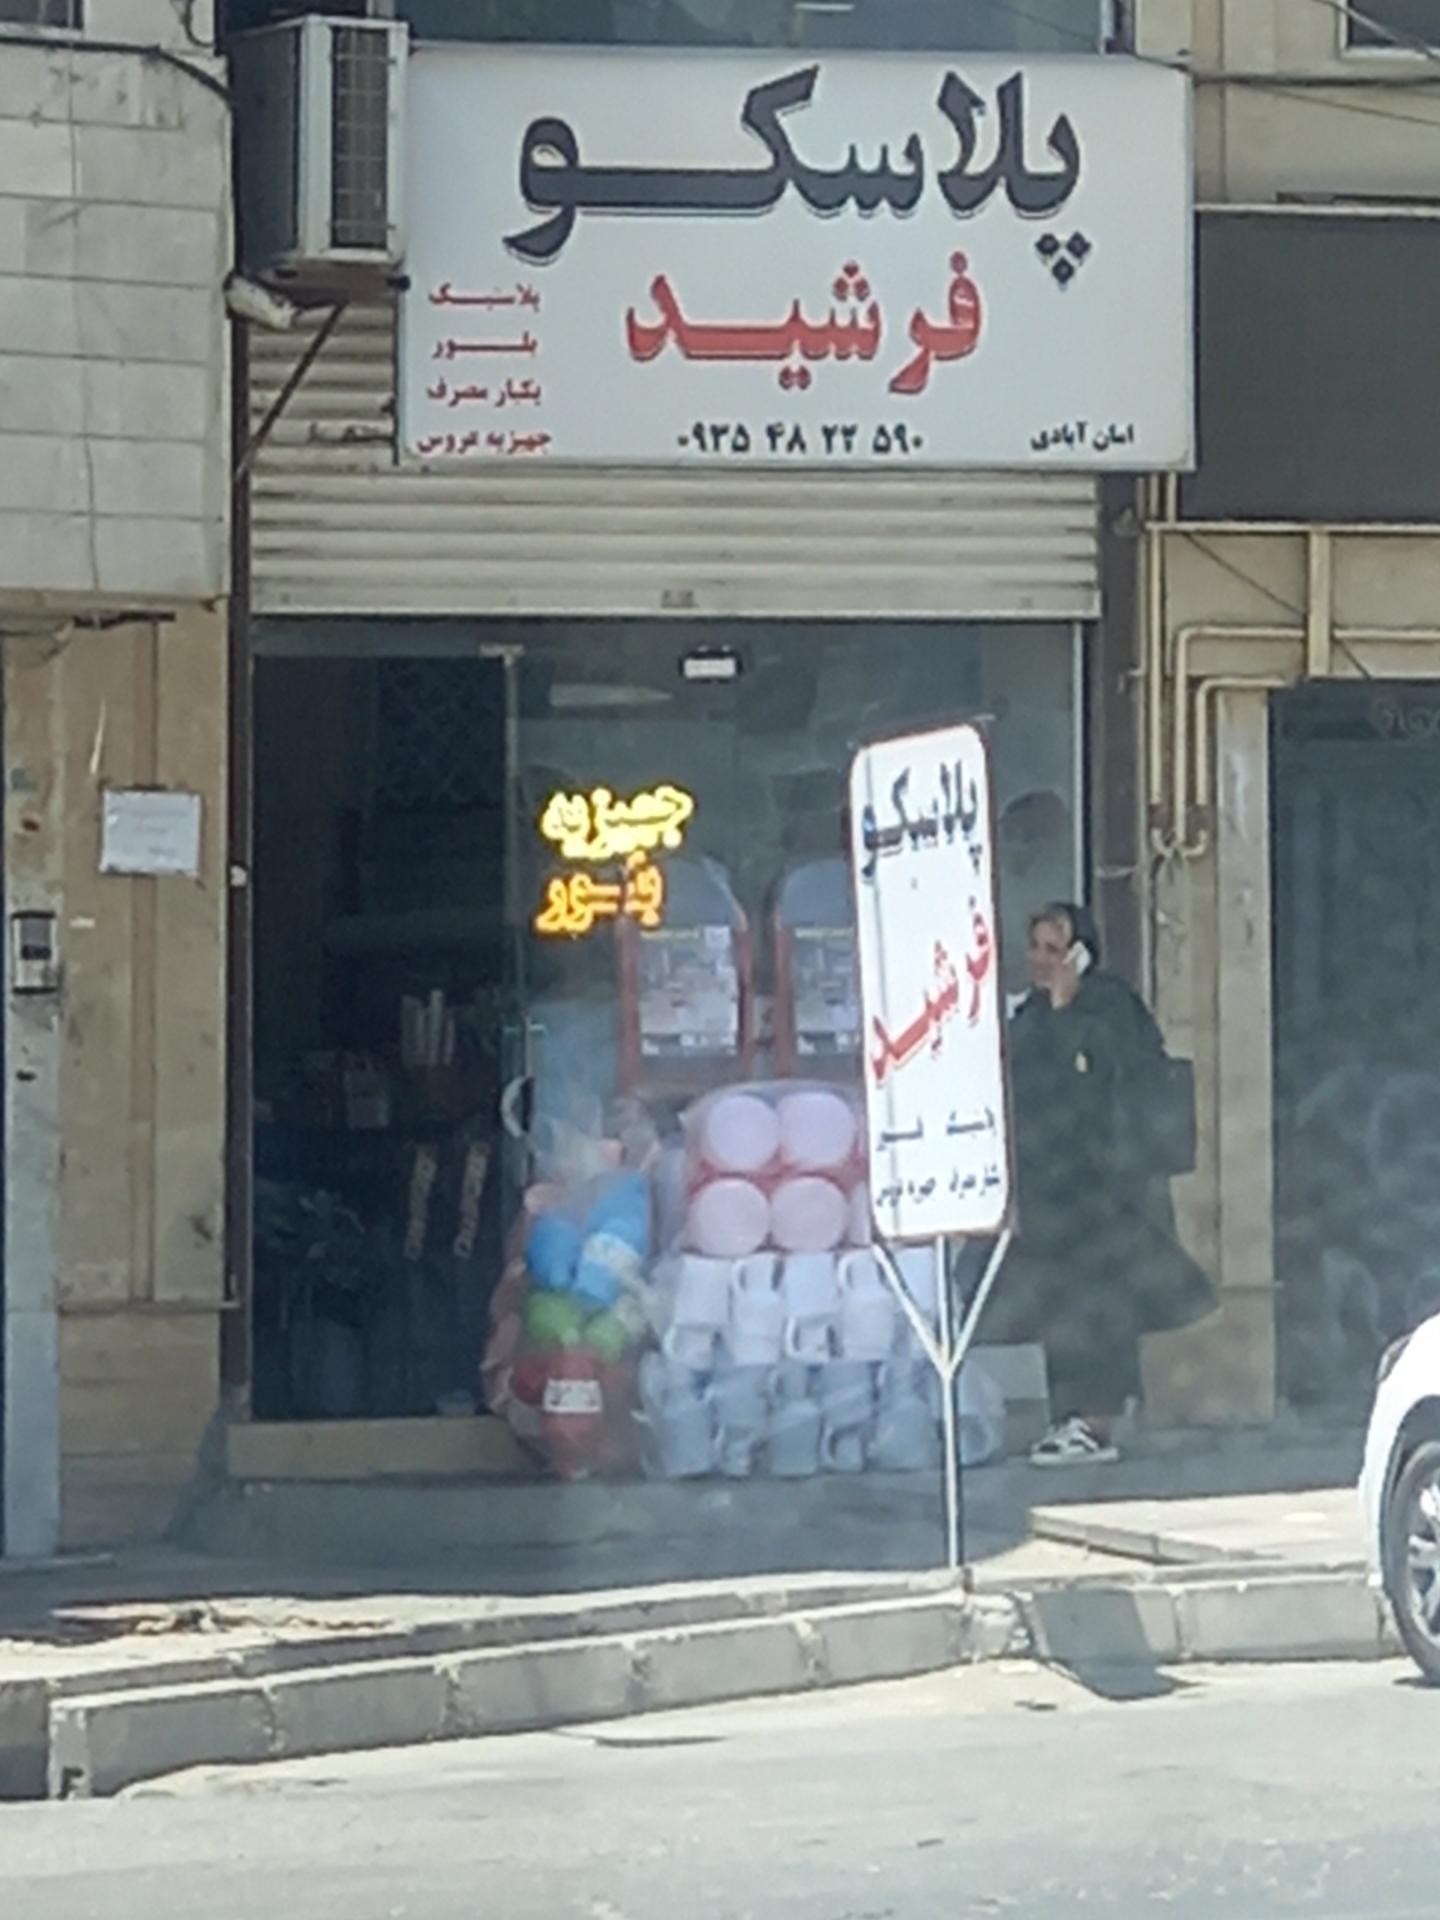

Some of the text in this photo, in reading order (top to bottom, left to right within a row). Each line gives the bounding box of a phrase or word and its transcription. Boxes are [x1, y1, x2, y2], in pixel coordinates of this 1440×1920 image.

[502, 65, 1092, 292] پلاسکو
[625, 250, 984, 395] فرشید
[871, 894, 991, 1090] فرشید
